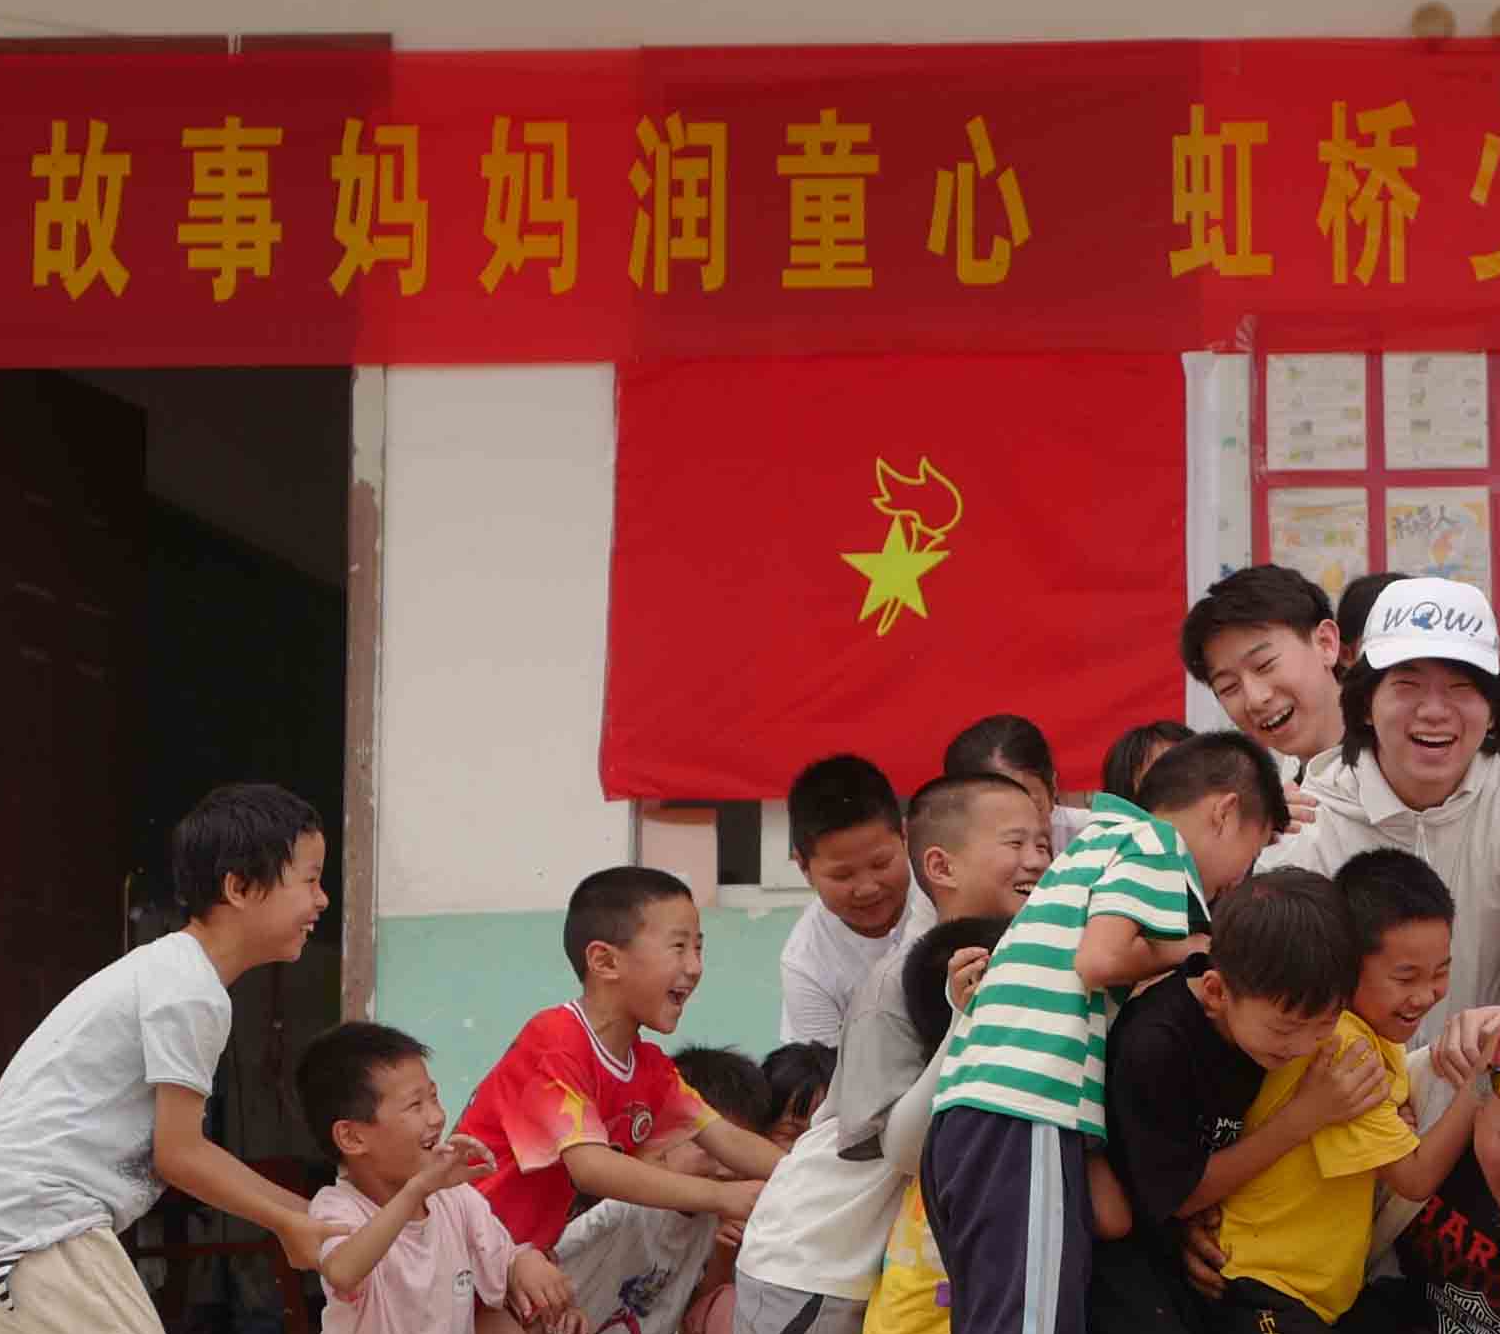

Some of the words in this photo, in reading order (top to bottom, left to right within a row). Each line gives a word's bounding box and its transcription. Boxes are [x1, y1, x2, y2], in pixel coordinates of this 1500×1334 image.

[30, 107, 1031, 302] 故事妈妈润童心
